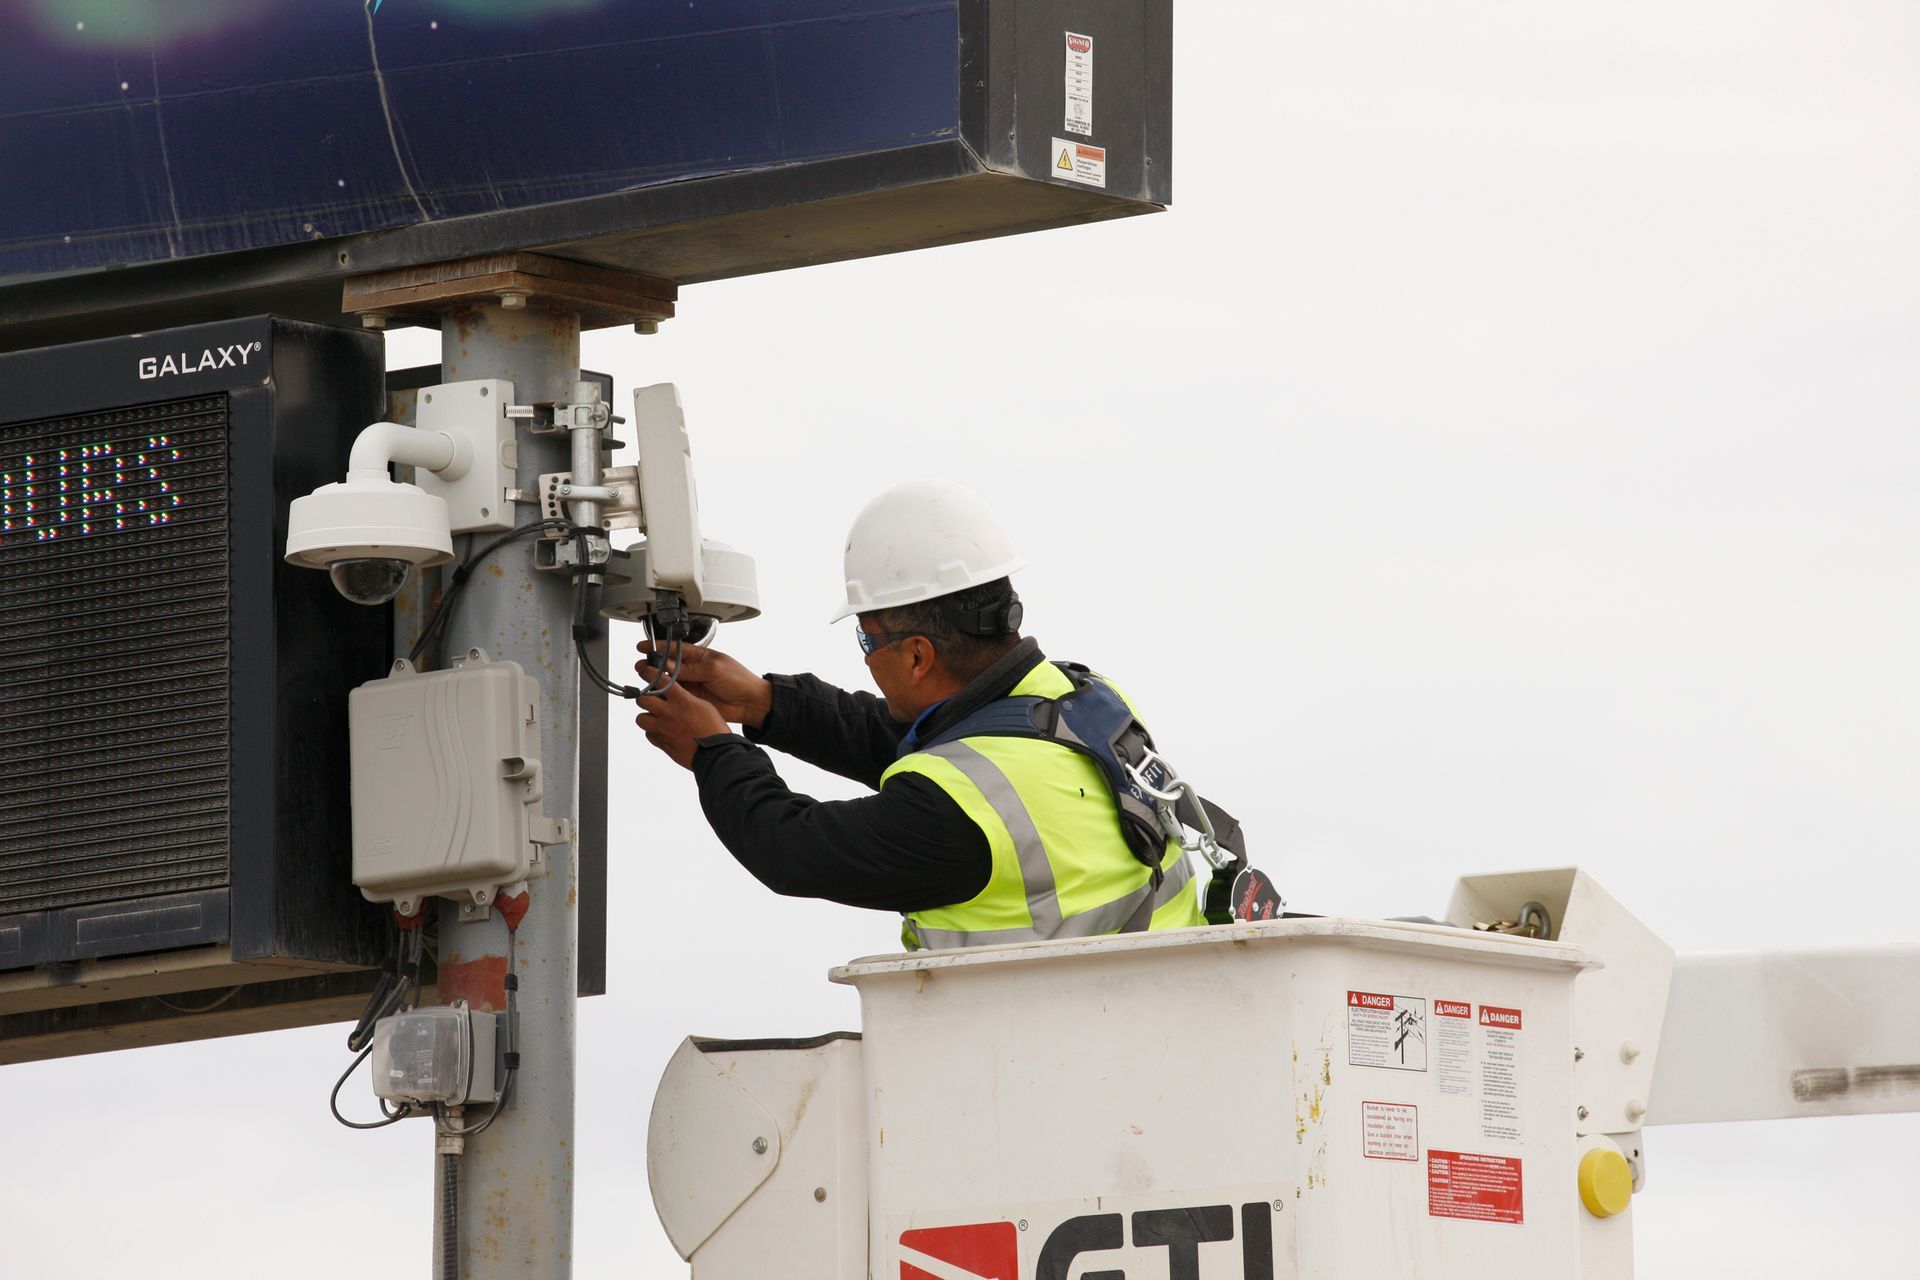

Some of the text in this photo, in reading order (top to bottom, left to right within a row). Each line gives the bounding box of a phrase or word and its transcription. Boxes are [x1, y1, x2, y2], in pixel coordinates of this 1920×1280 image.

[1362, 996, 1391, 1007] DANGER
[1444, 1005, 1468, 1015] DANGER
[1490, 1013, 1519, 1024] DANGER
